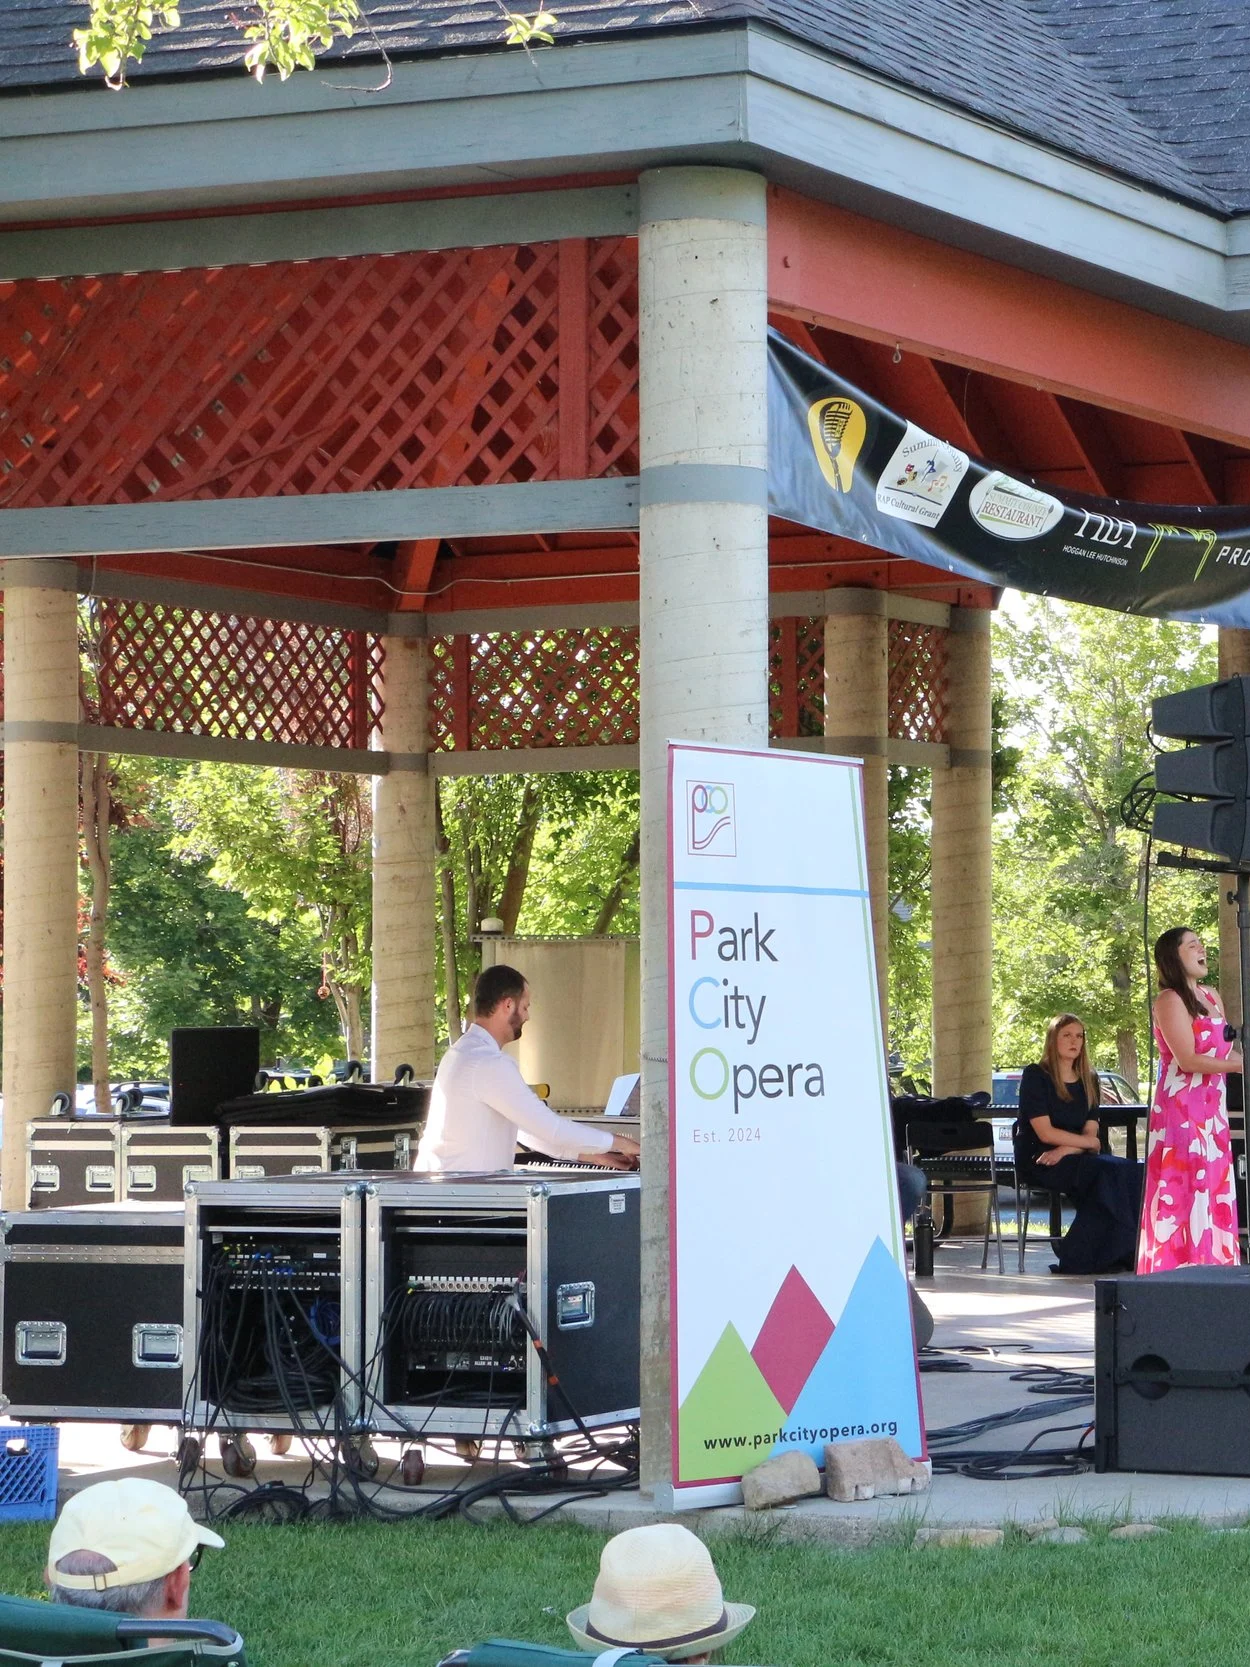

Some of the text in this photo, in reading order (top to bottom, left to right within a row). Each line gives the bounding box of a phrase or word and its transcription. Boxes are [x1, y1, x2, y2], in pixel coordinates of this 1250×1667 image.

[902, 438, 941, 458] Summ
[890, 498, 918, 513] Cultural
[919, 506, 940, 520] Grant
[982, 502, 1043, 528] RESTAURANT
[1062, 545, 1129, 566] HOGGAN LEE HUTCHINSON
[690, 909, 779, 962] Park
[689, 976, 767, 1045] City
[689, 1047, 826, 1114] Opera
[693, 1127, 761, 1143] Est. 2024
[703, 1419, 898, 1450] www.parkcityopera.org
